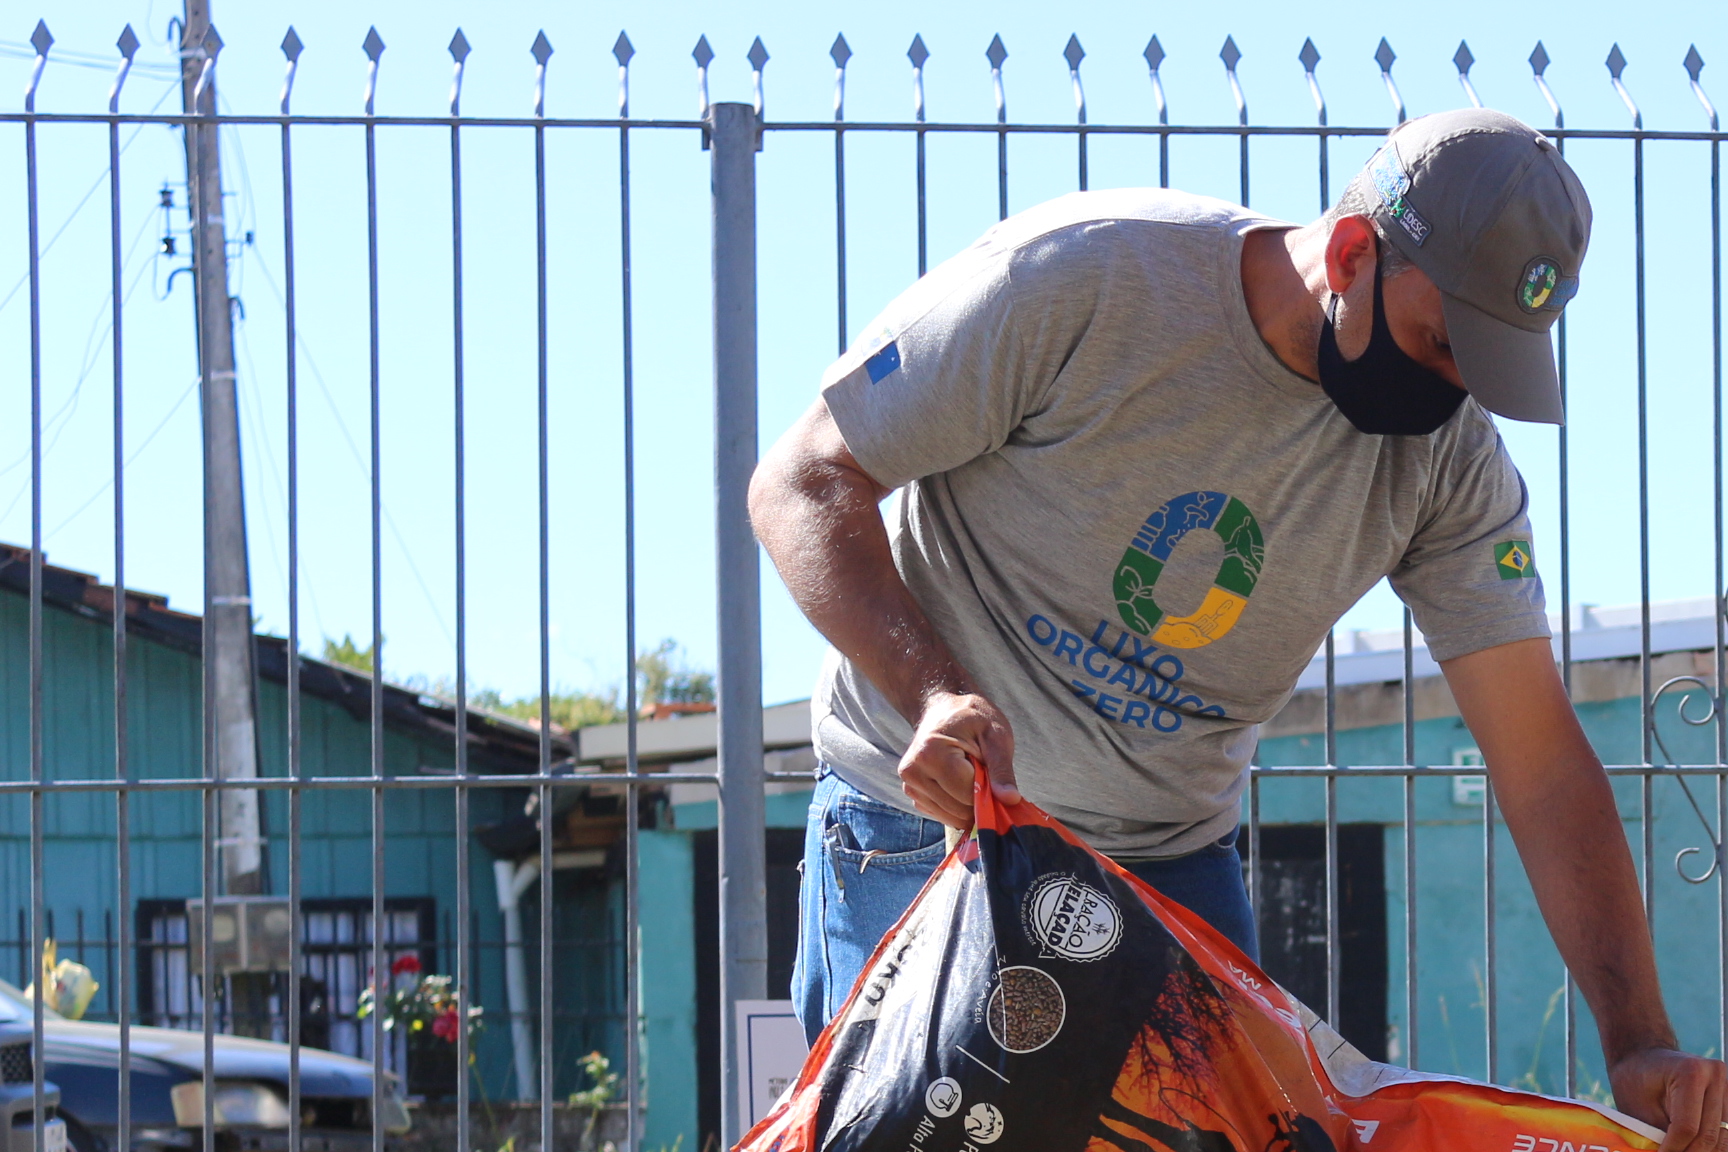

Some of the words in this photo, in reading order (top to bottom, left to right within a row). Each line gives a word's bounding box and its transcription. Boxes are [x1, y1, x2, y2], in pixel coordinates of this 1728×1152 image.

[1403, 209, 1428, 237] UDESC
[1090, 620, 1184, 683] LIXO
[1070, 680, 1183, 733] ZERO
[1069, 897, 1099, 948] RAÇÃO
[974, 989, 988, 1024] Aveia
[913, 1115, 936, 1143] Alta
